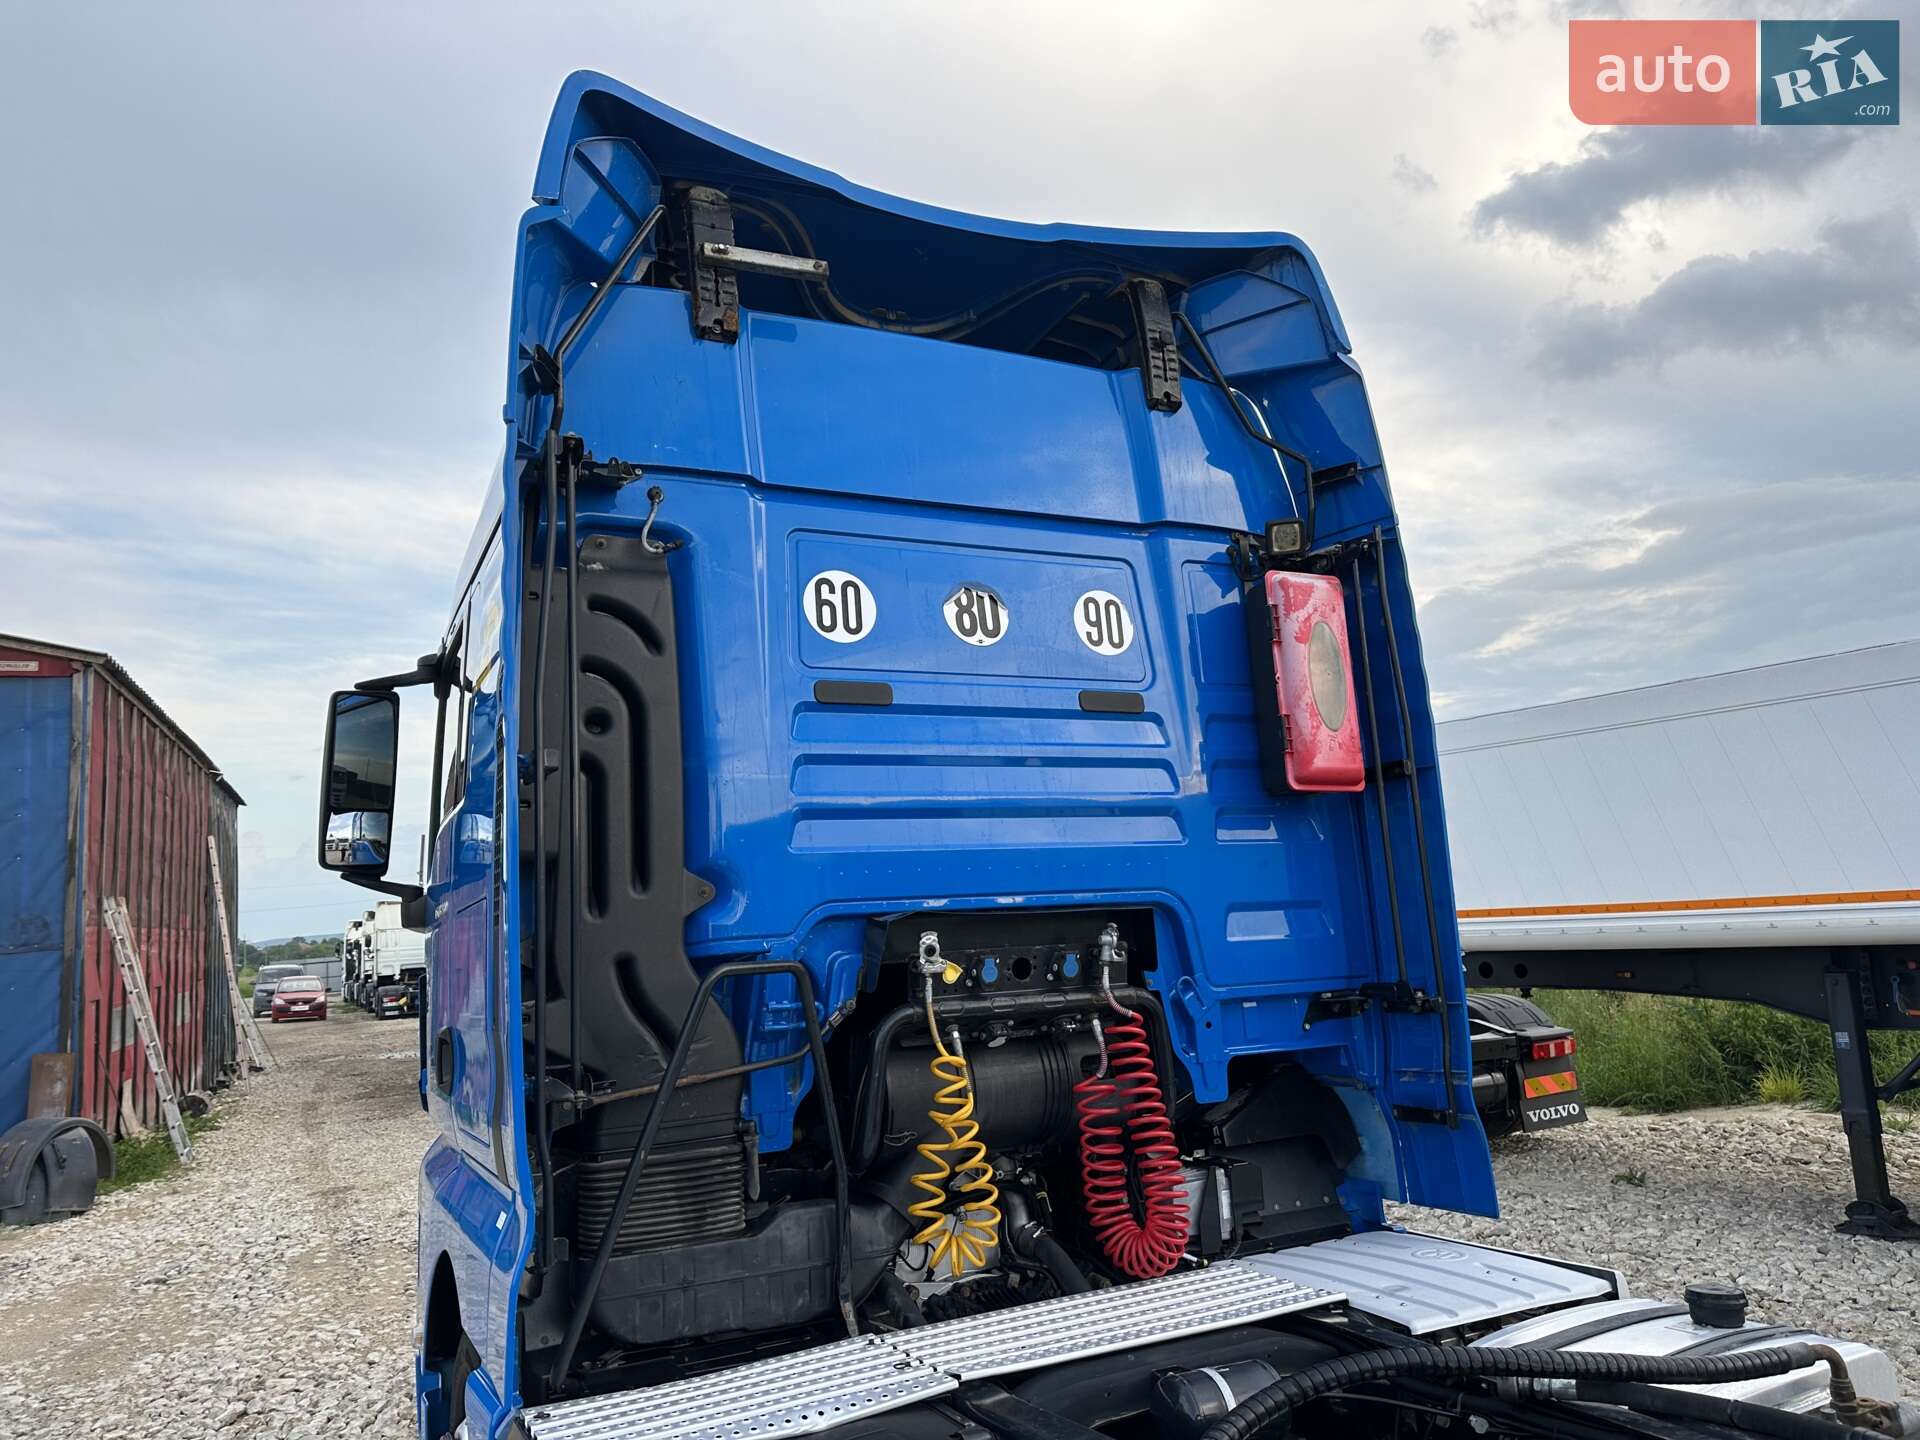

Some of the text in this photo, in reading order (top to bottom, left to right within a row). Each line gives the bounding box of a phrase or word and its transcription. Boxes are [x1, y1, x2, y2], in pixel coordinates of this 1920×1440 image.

[814, 577, 863, 635] 60
[954, 587, 1002, 638] 80
[1083, 596, 1125, 649] 90
[1526, 1103, 1580, 1123] VOLVO
